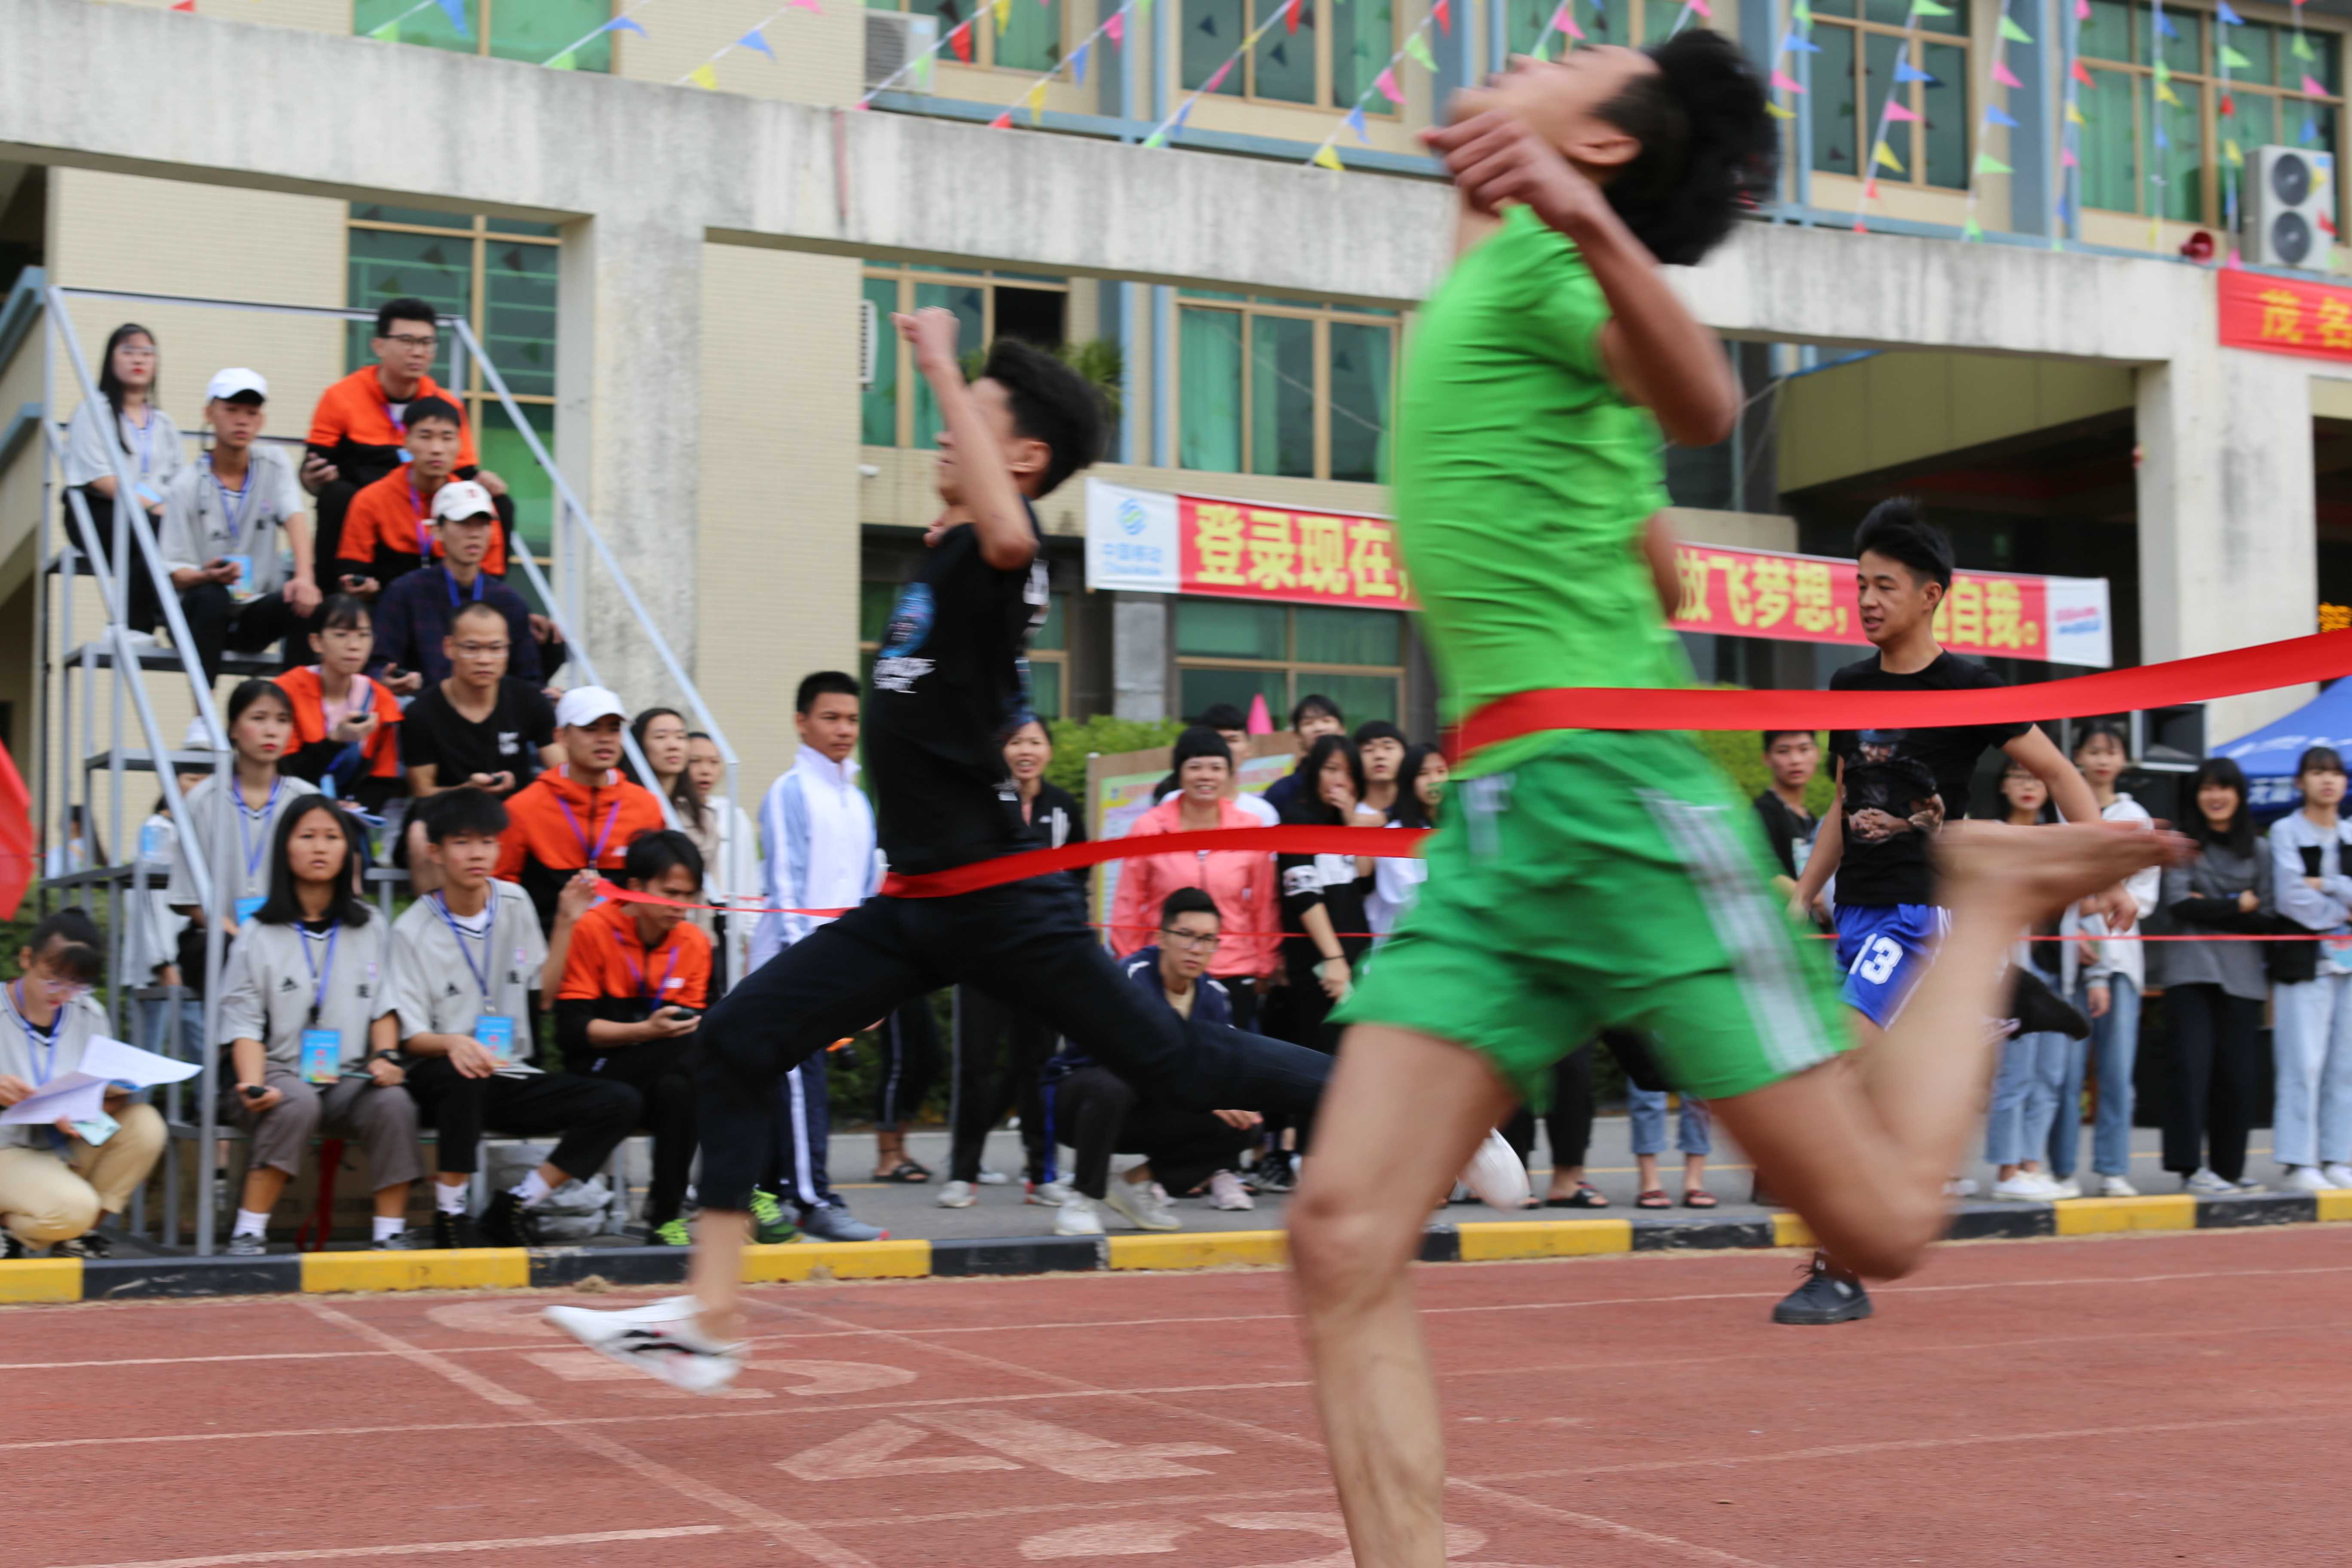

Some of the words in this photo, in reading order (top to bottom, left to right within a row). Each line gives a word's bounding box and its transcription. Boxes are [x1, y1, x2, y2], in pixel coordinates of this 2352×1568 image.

[1932, 576, 2039, 649] 自我。
[1849, 933, 1903, 985] 13
[771, 1408, 1238, 1483] 4
